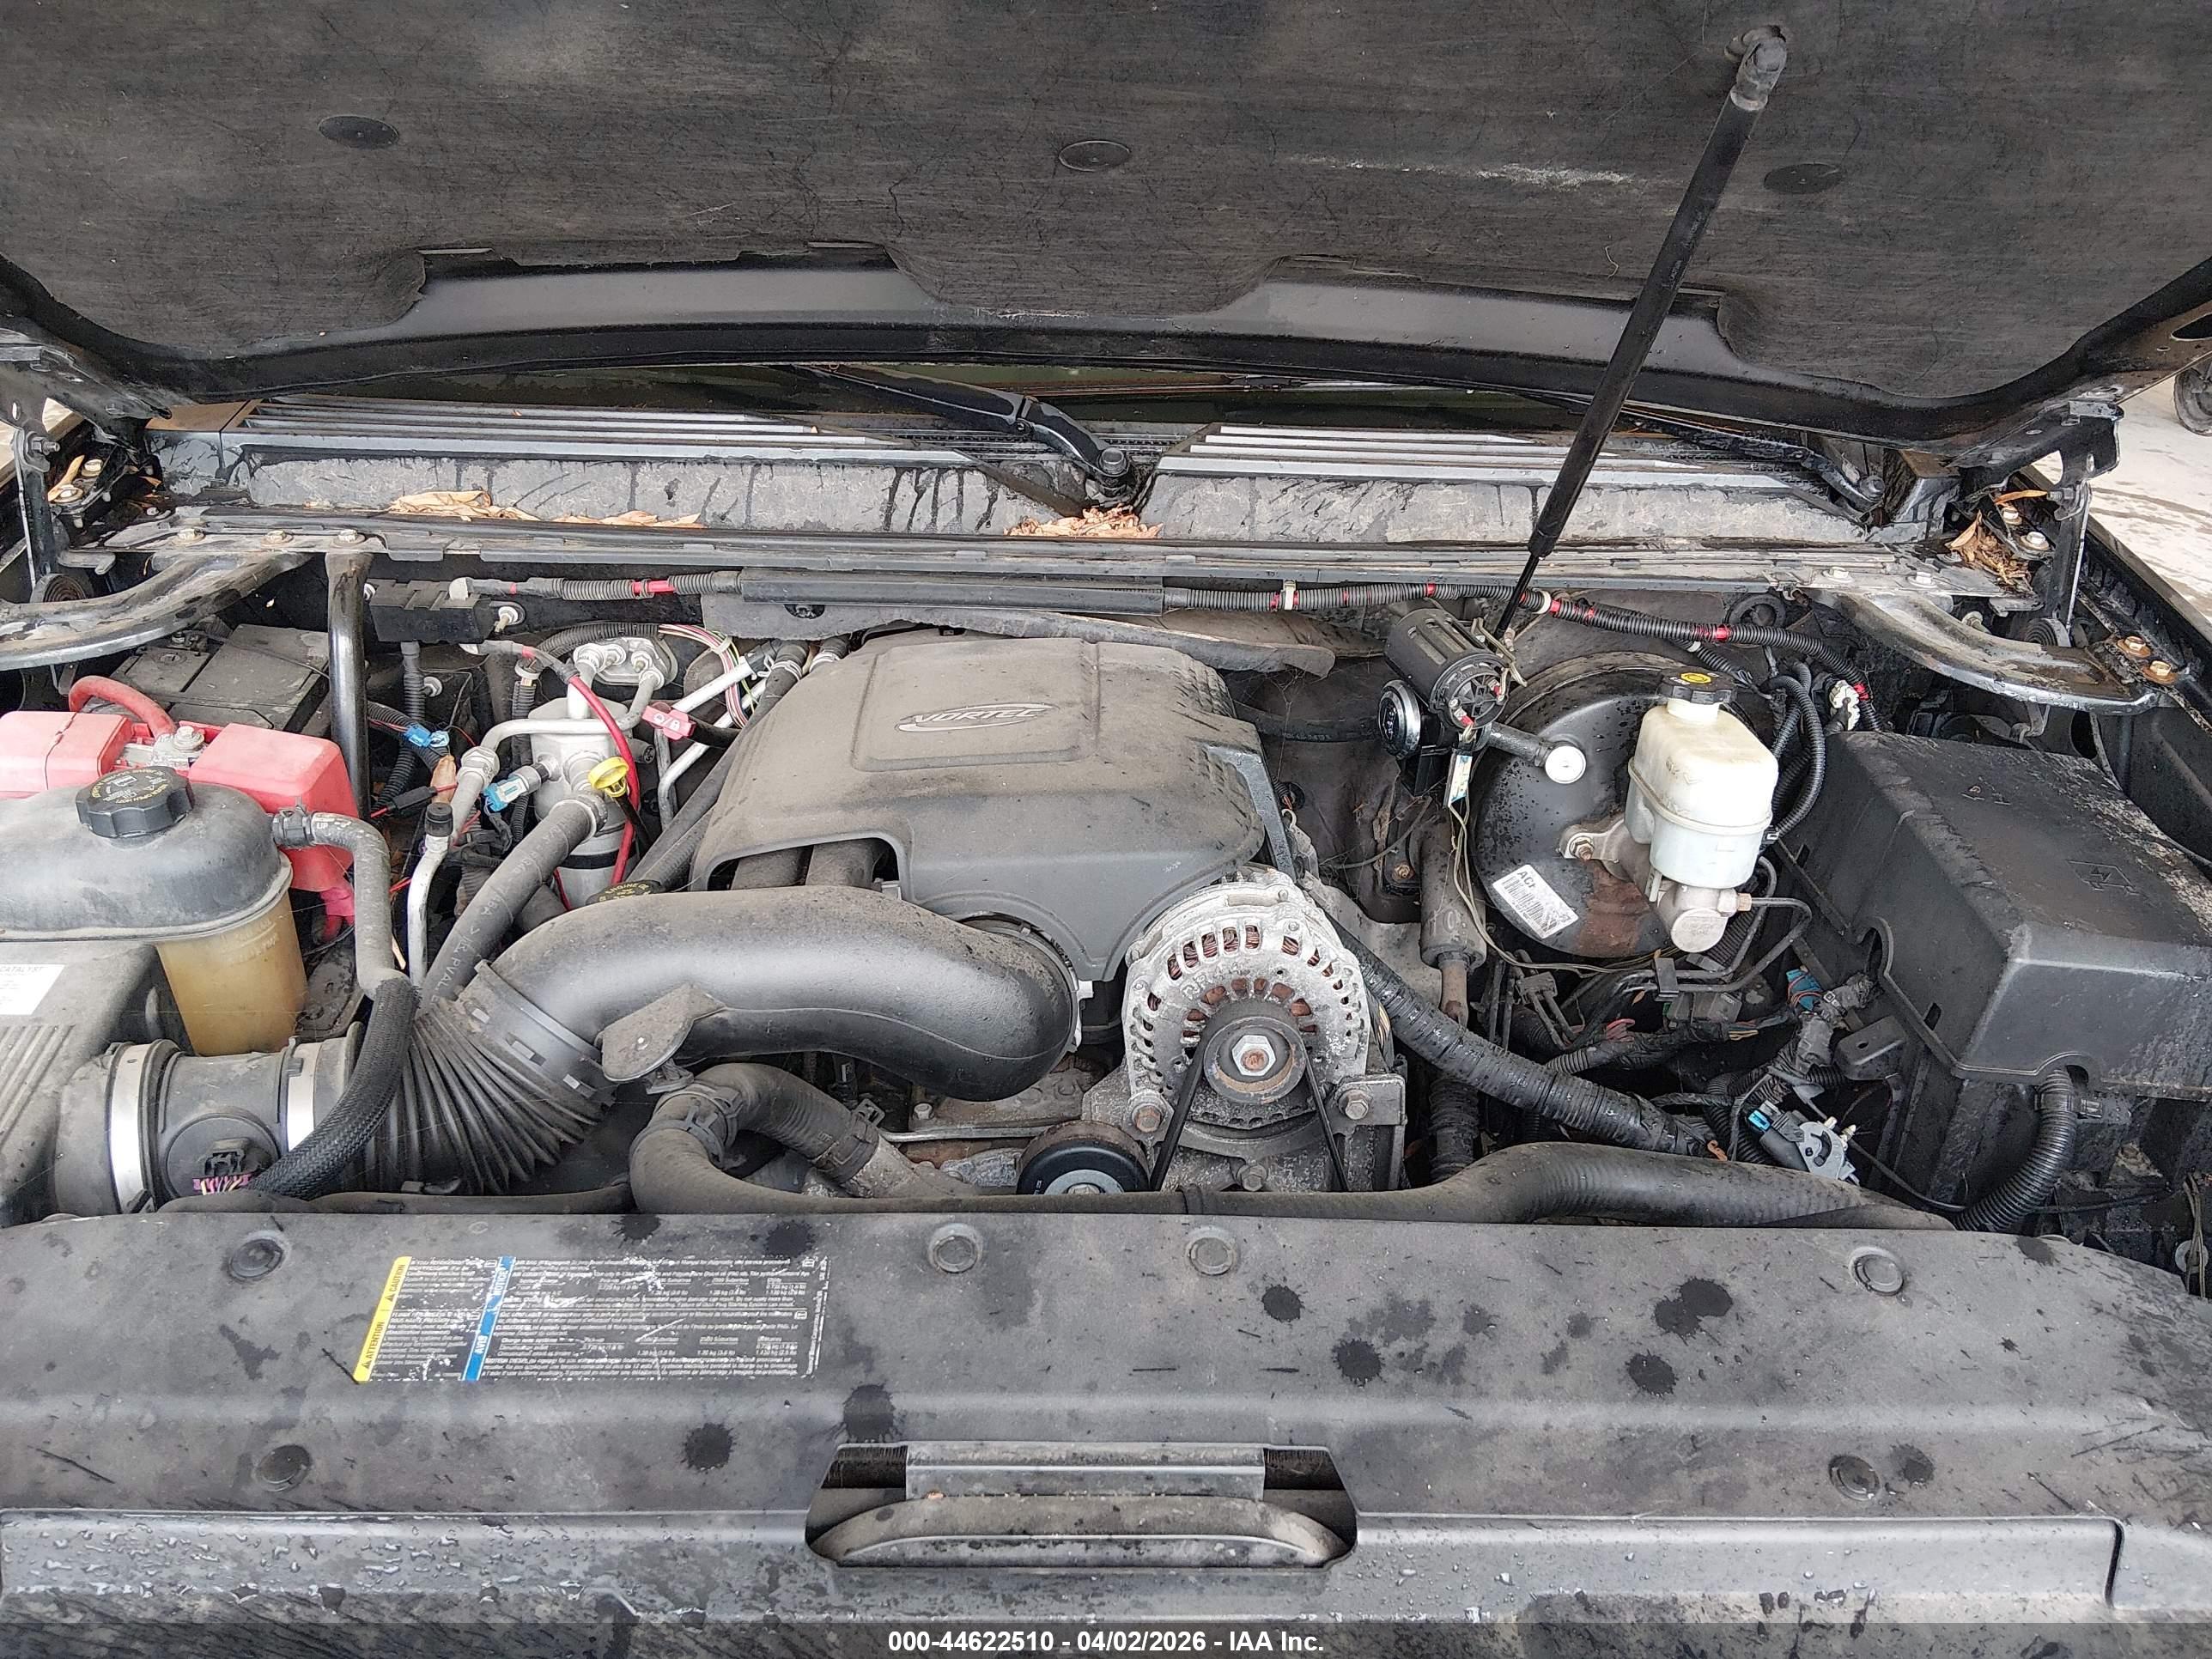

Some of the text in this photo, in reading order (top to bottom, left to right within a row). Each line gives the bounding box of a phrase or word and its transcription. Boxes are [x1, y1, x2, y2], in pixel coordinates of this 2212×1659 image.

[913, 708, 1045, 723] VORTEC
[389, 1264, 406, 1292] CAUTION
[494, 1269, 509, 1296] NOTICE
[368, 1322, 385, 1358] ATTENTION
[474, 1335, 489, 1355] AVIS
